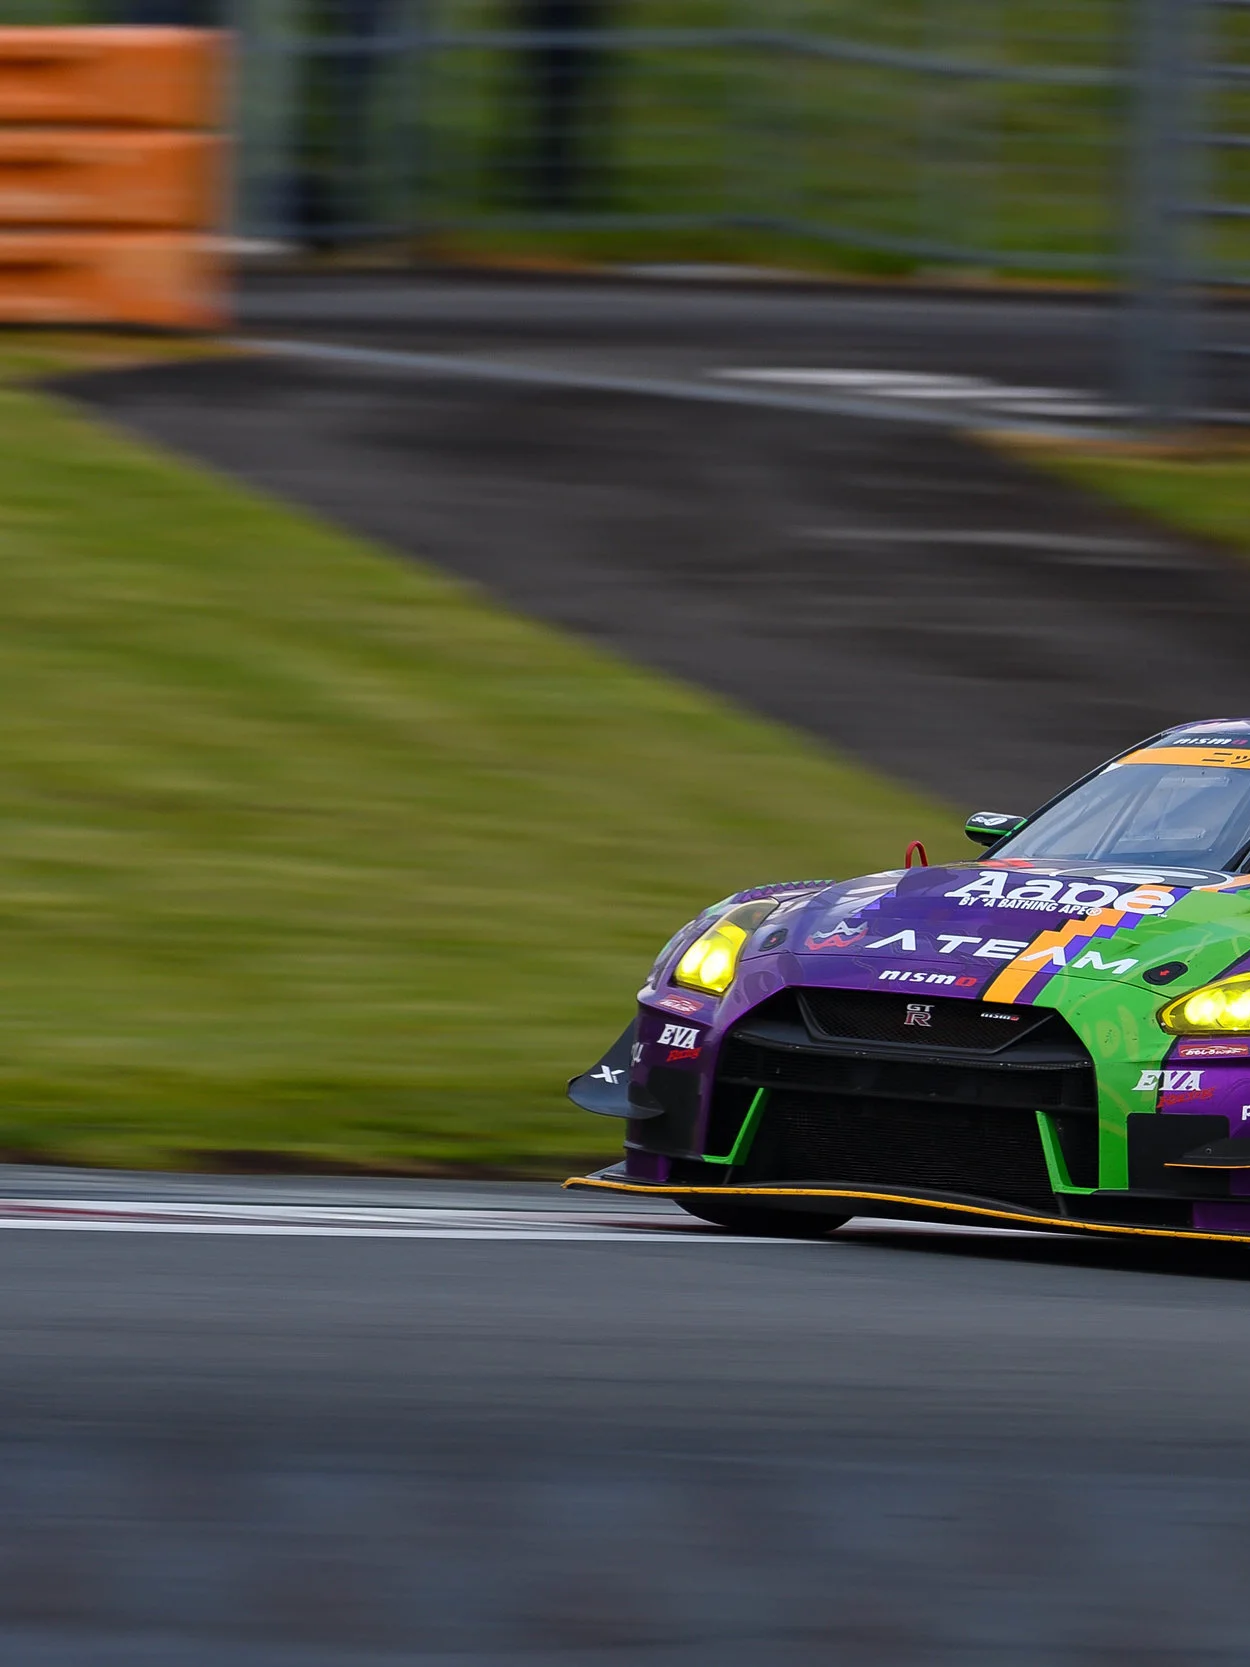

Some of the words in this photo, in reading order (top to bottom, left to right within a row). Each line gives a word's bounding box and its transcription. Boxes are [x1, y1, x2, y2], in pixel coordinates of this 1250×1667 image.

[1172, 737, 1249, 746] nismo
[944, 871, 1176, 915] Aape
[958, 896, 981, 907] BY
[998, 898, 1057, 913] BATHING
[935, 933, 1140, 975] TEAM
[878, 969, 977, 987] nismo
[980, 1011, 1019, 1021] nismo
[656, 1023, 701, 1050] EVA
[1131, 1070, 1206, 1091] EVA
